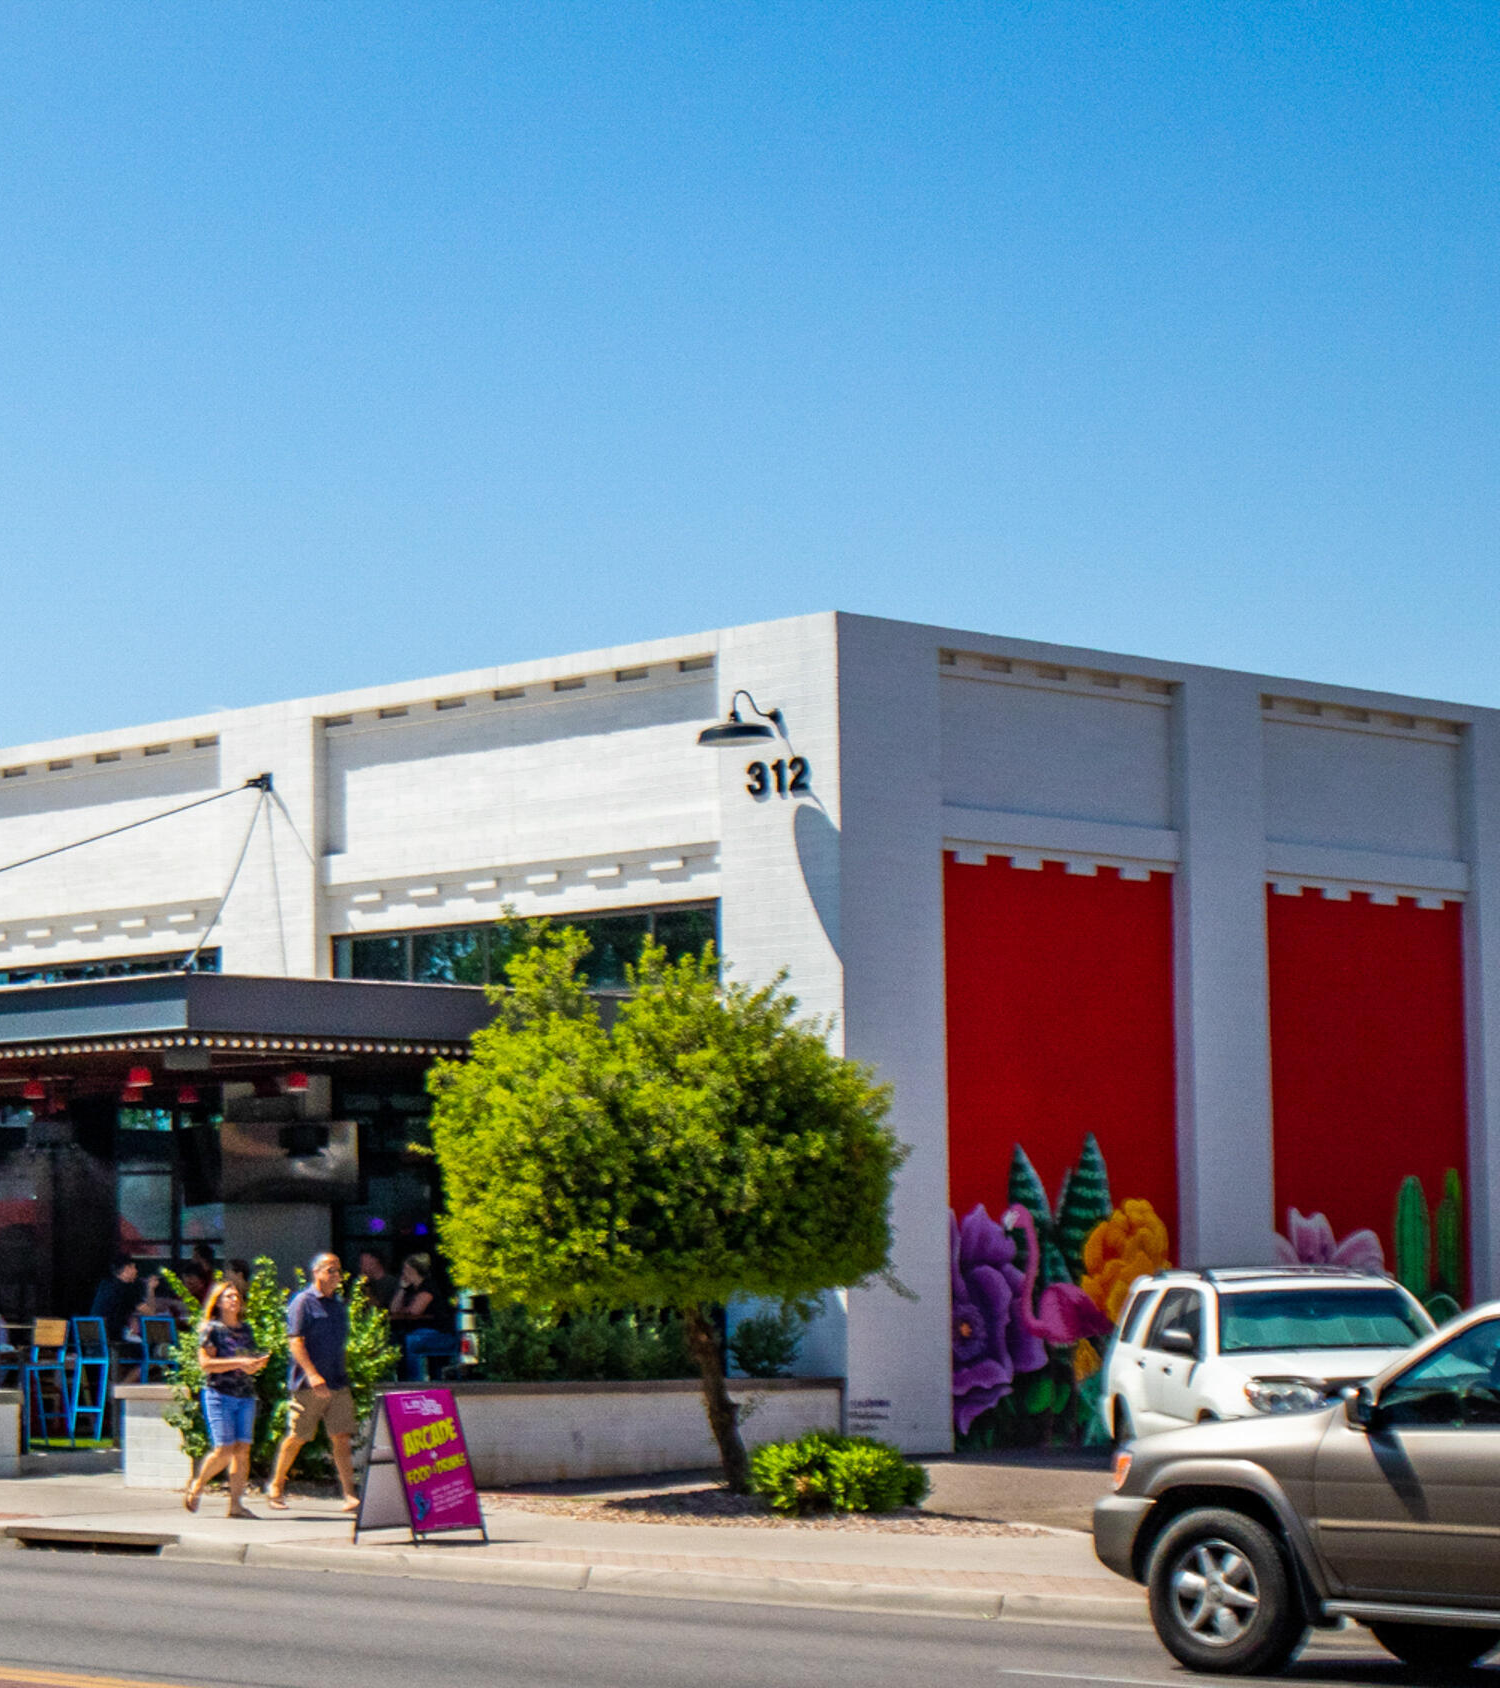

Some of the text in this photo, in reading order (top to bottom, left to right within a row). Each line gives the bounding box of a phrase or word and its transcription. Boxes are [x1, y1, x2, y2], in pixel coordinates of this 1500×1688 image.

[746, 757, 810, 796] 312
[402, 1416, 458, 1458] ARCADE
[406, 1465, 431, 1486] FOOD
